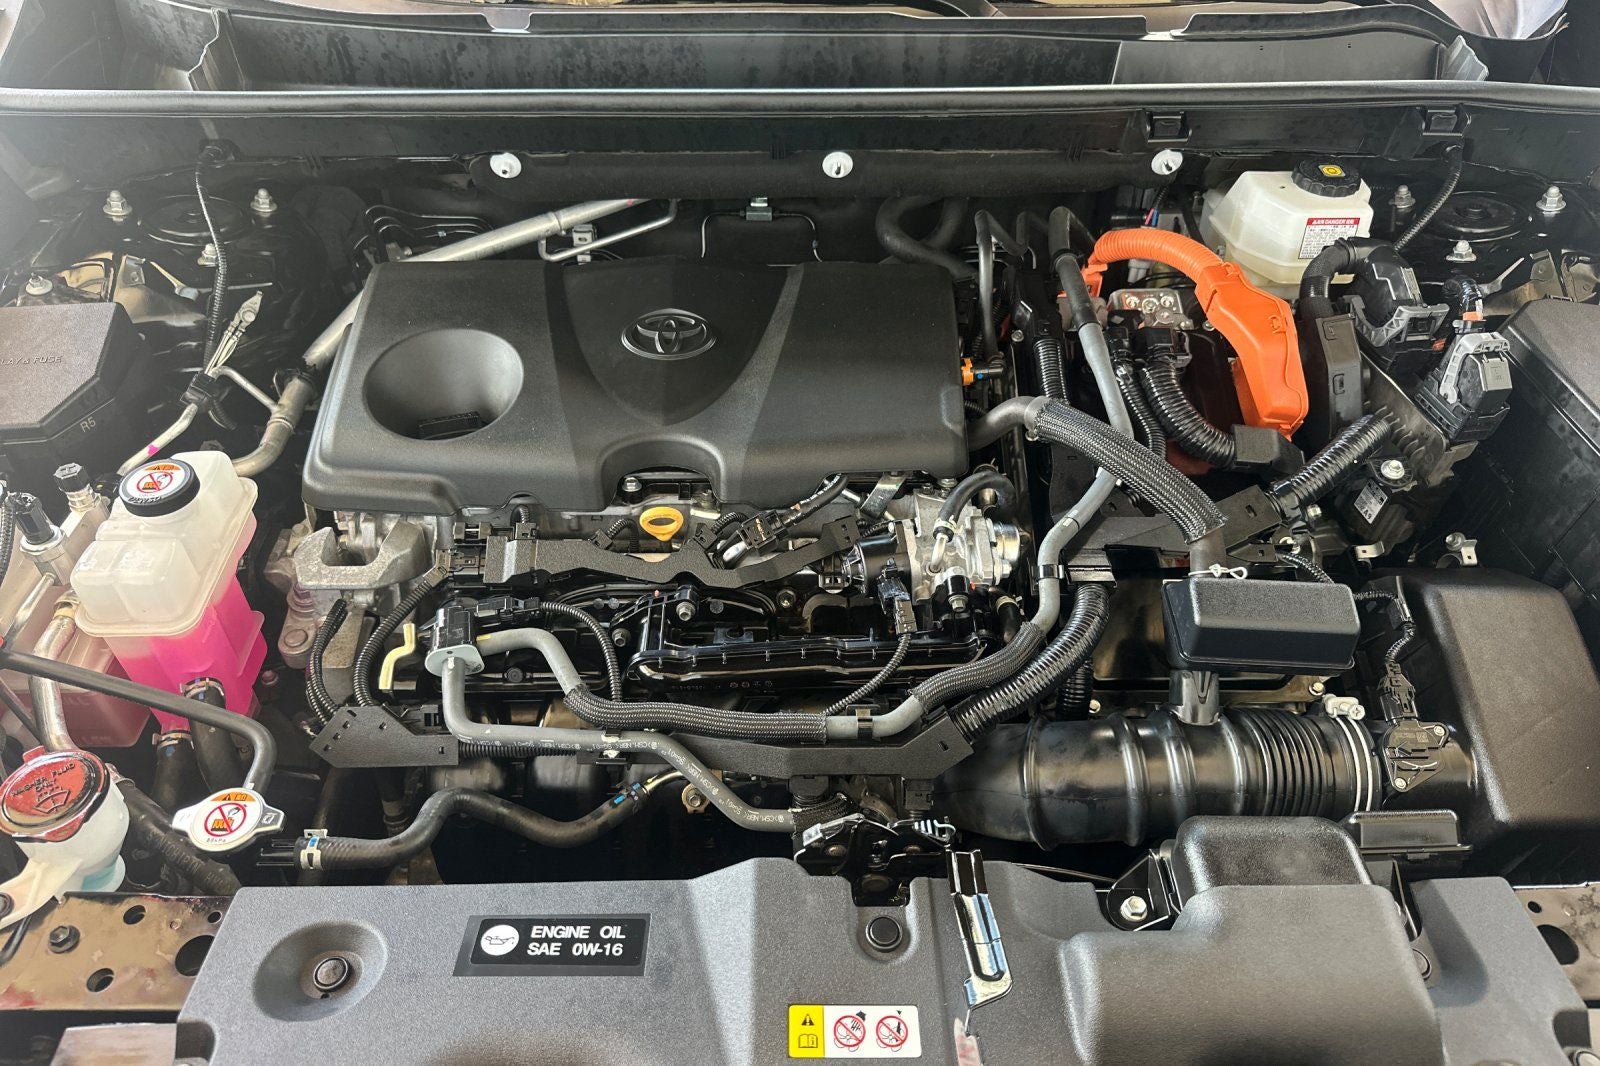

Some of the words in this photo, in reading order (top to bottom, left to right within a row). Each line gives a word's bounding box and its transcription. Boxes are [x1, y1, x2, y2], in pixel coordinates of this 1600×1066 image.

[33, 355, 63, 364] FUSE
[11, 776, 48, 797] WASHER
[51, 762, 76, 778] FLUID
[35, 778, 57, 793] ONLY
[531, 926, 590, 938] ENGINE
[600, 926, 625, 938] OIL
[527, 943, 561, 955] SAE
[572, 943, 623, 955] 0W-16
